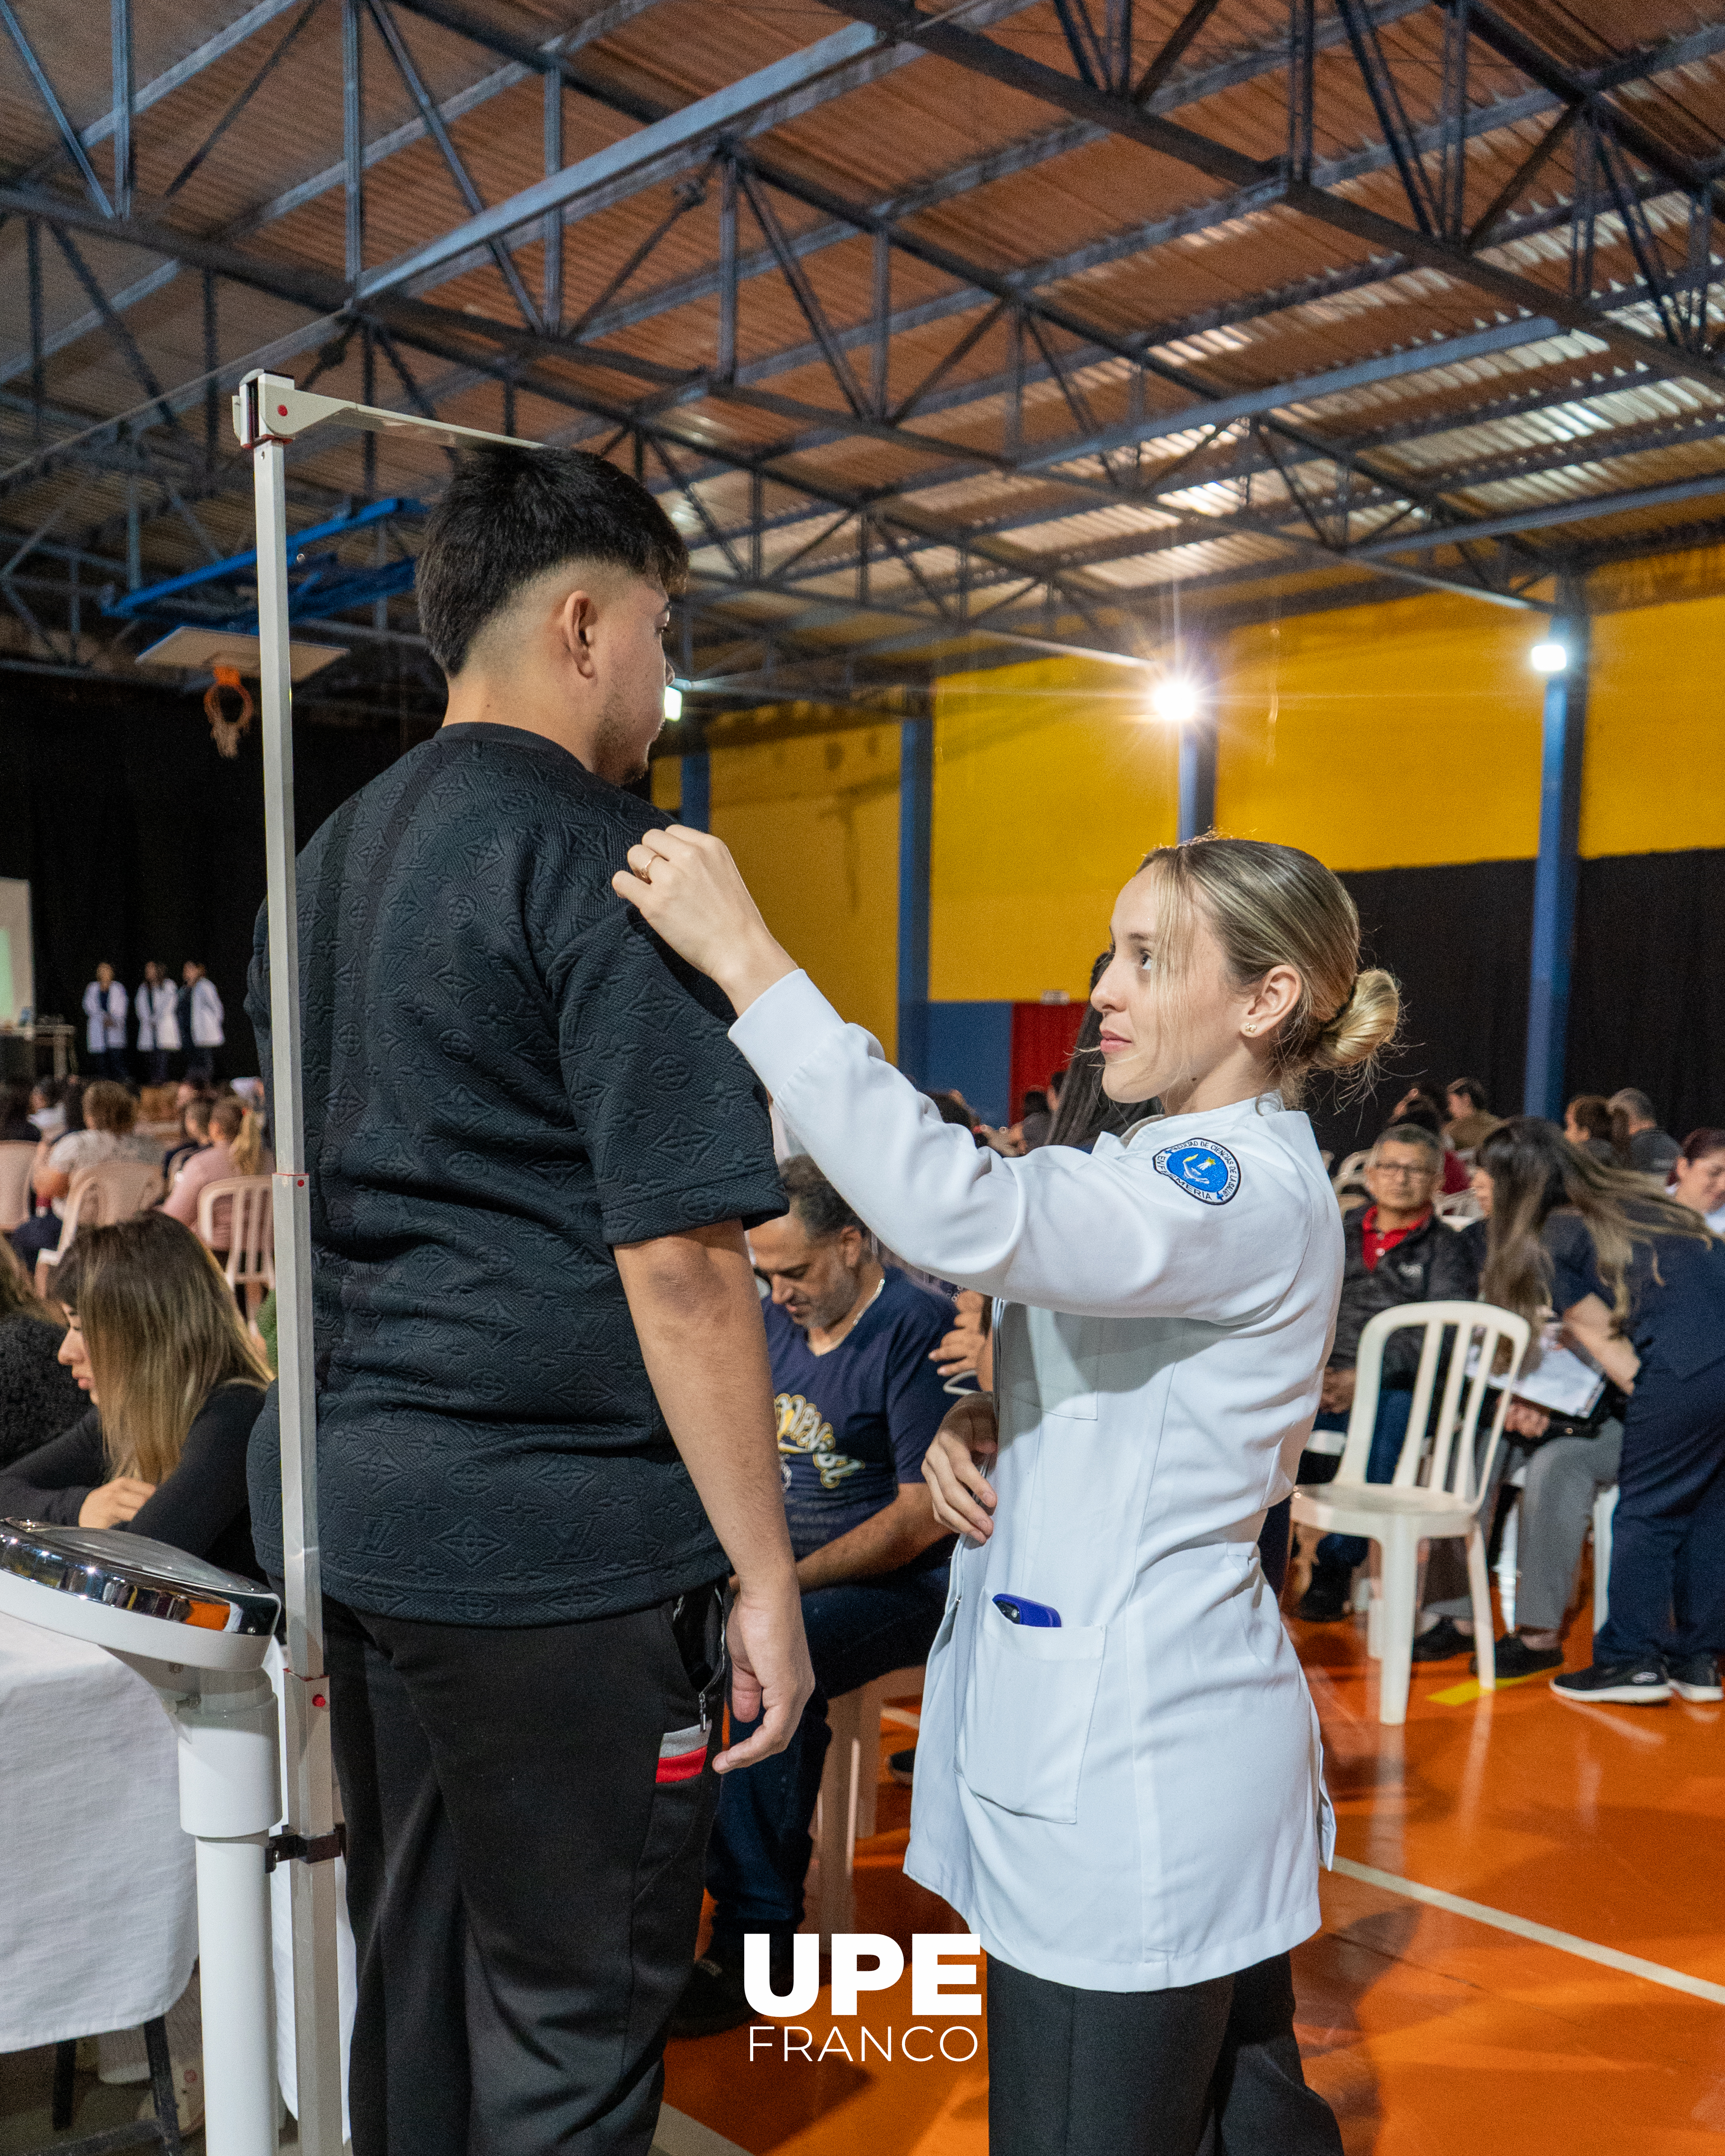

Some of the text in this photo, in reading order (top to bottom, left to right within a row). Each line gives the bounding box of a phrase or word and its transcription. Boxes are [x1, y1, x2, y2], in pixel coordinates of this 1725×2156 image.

[1171, 1141, 1198, 1150] FACULTAD
[1211, 1145, 1233, 1165] CIENCIAS
[1157, 1155, 1212, 1200] ENFERMERIA
